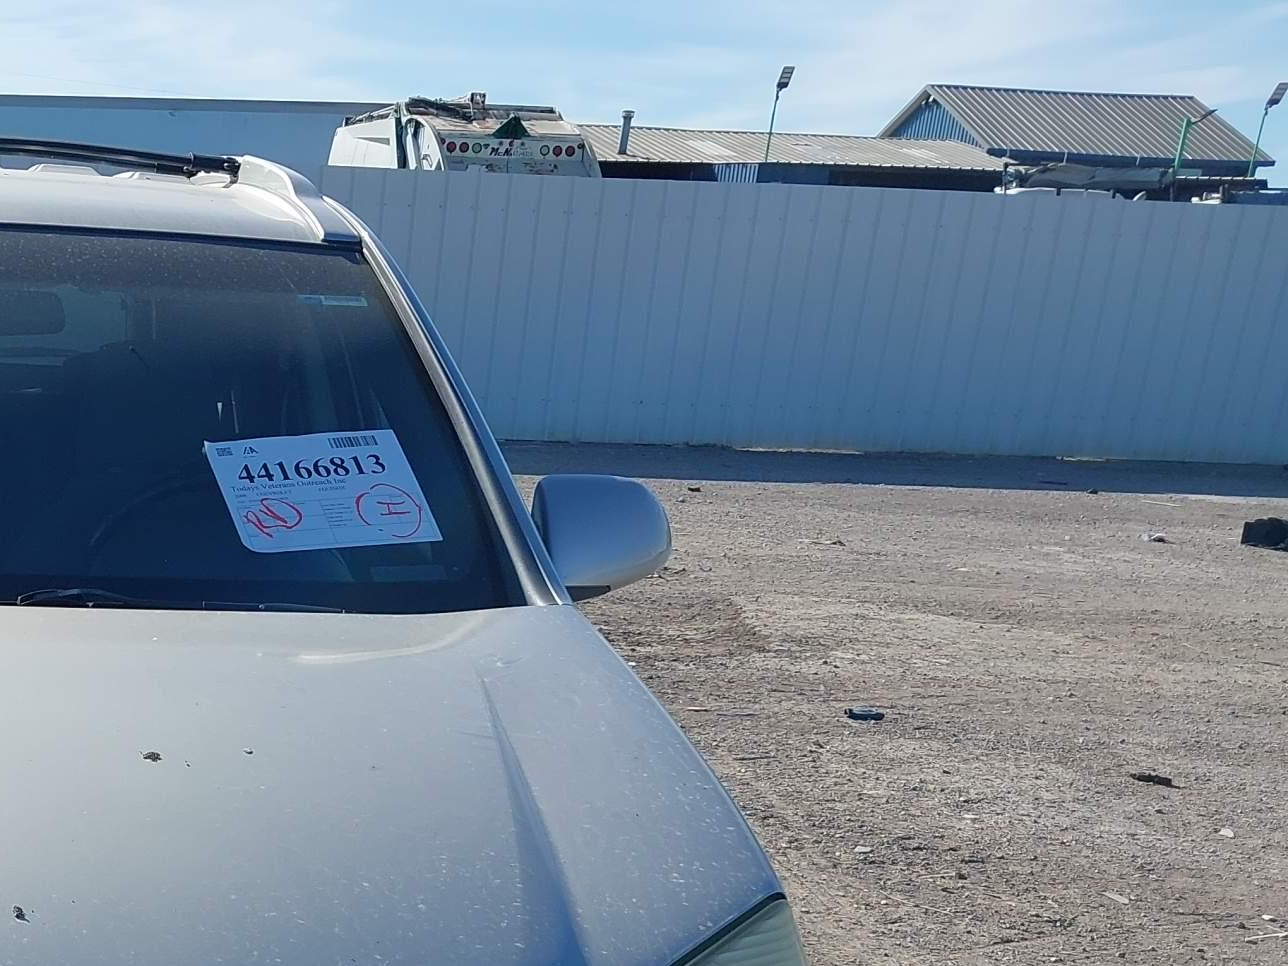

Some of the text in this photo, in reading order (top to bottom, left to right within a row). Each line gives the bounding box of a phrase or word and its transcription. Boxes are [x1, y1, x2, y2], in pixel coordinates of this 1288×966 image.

[238, 454, 387, 484] 44166813
[230, 485, 260, 494] Todays
[260, 481, 296, 491] Veterans
[296, 478, 333, 488] Outreach
